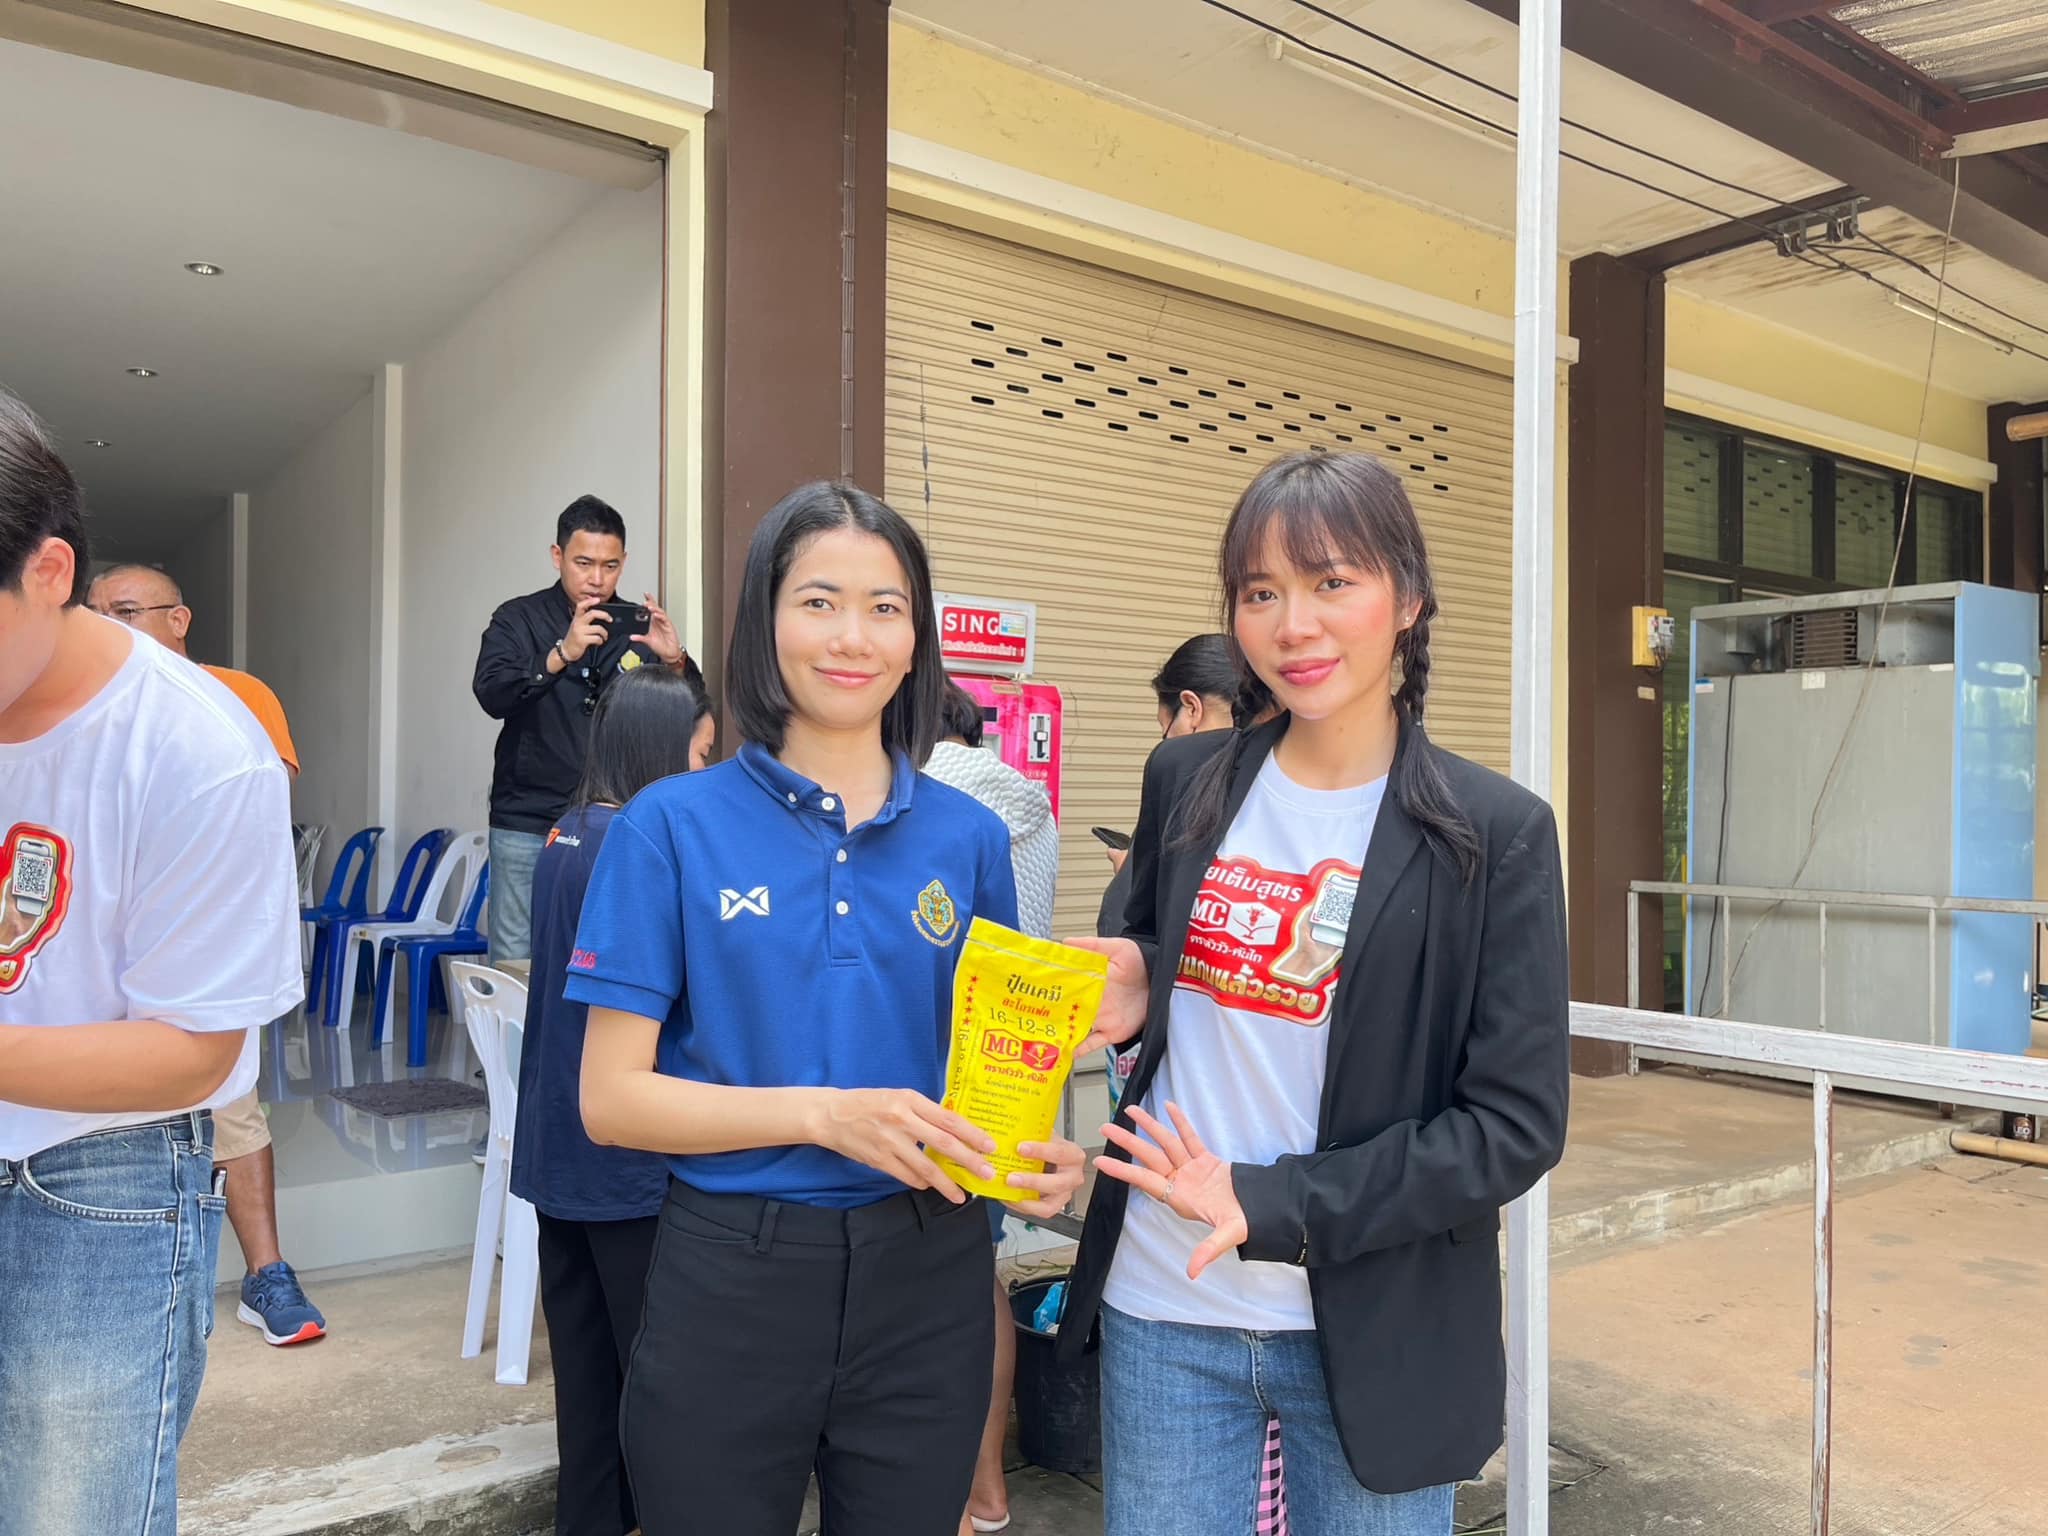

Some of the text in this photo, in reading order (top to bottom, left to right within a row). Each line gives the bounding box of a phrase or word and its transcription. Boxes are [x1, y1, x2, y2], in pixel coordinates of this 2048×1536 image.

[1191, 897, 1228, 926] MC
[1006, 974, 1063, 1002] ปุ๋ยเคมี
[1176, 952, 1320, 1013] แกนแล้วรวย
[989, 1007, 1057, 1037] 16-12-8
[987, 1034, 1020, 1057] MC
